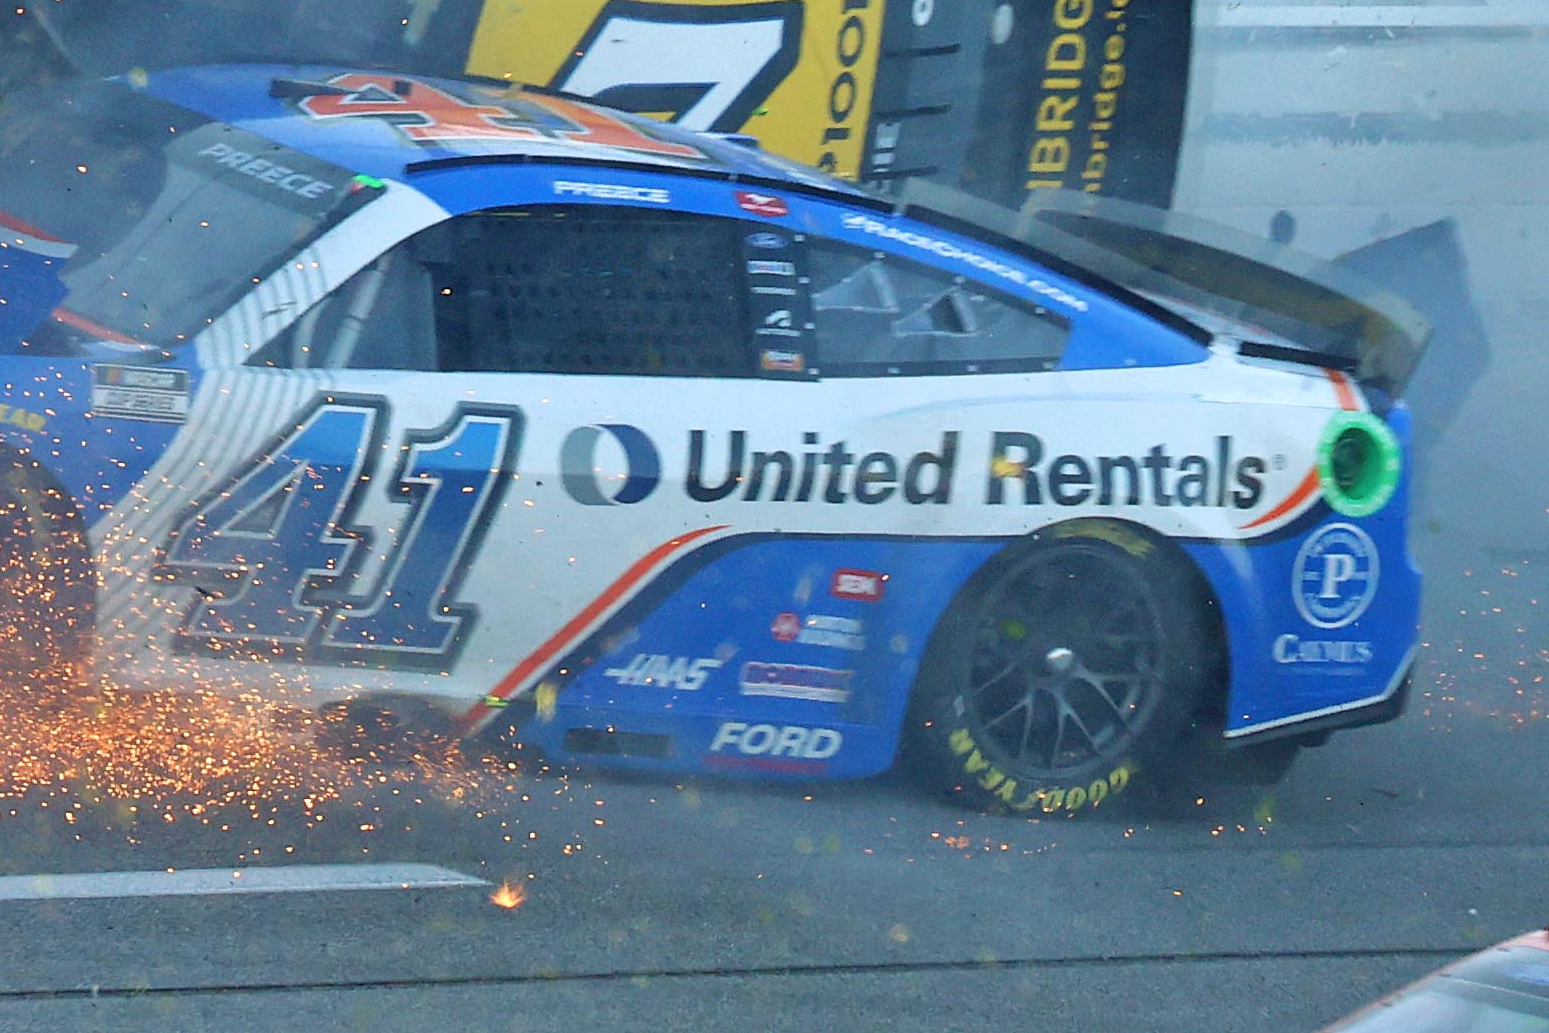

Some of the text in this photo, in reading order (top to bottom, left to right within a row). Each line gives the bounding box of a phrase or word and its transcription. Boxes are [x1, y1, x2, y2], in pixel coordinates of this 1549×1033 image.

[197, 142, 333, 200] PREECE
[553, 180, 671, 204] PREECE
[686, 429, 1266, 511] United Rentals
[156, 391, 525, 671] 41
[709, 721, 844, 759] FORD
